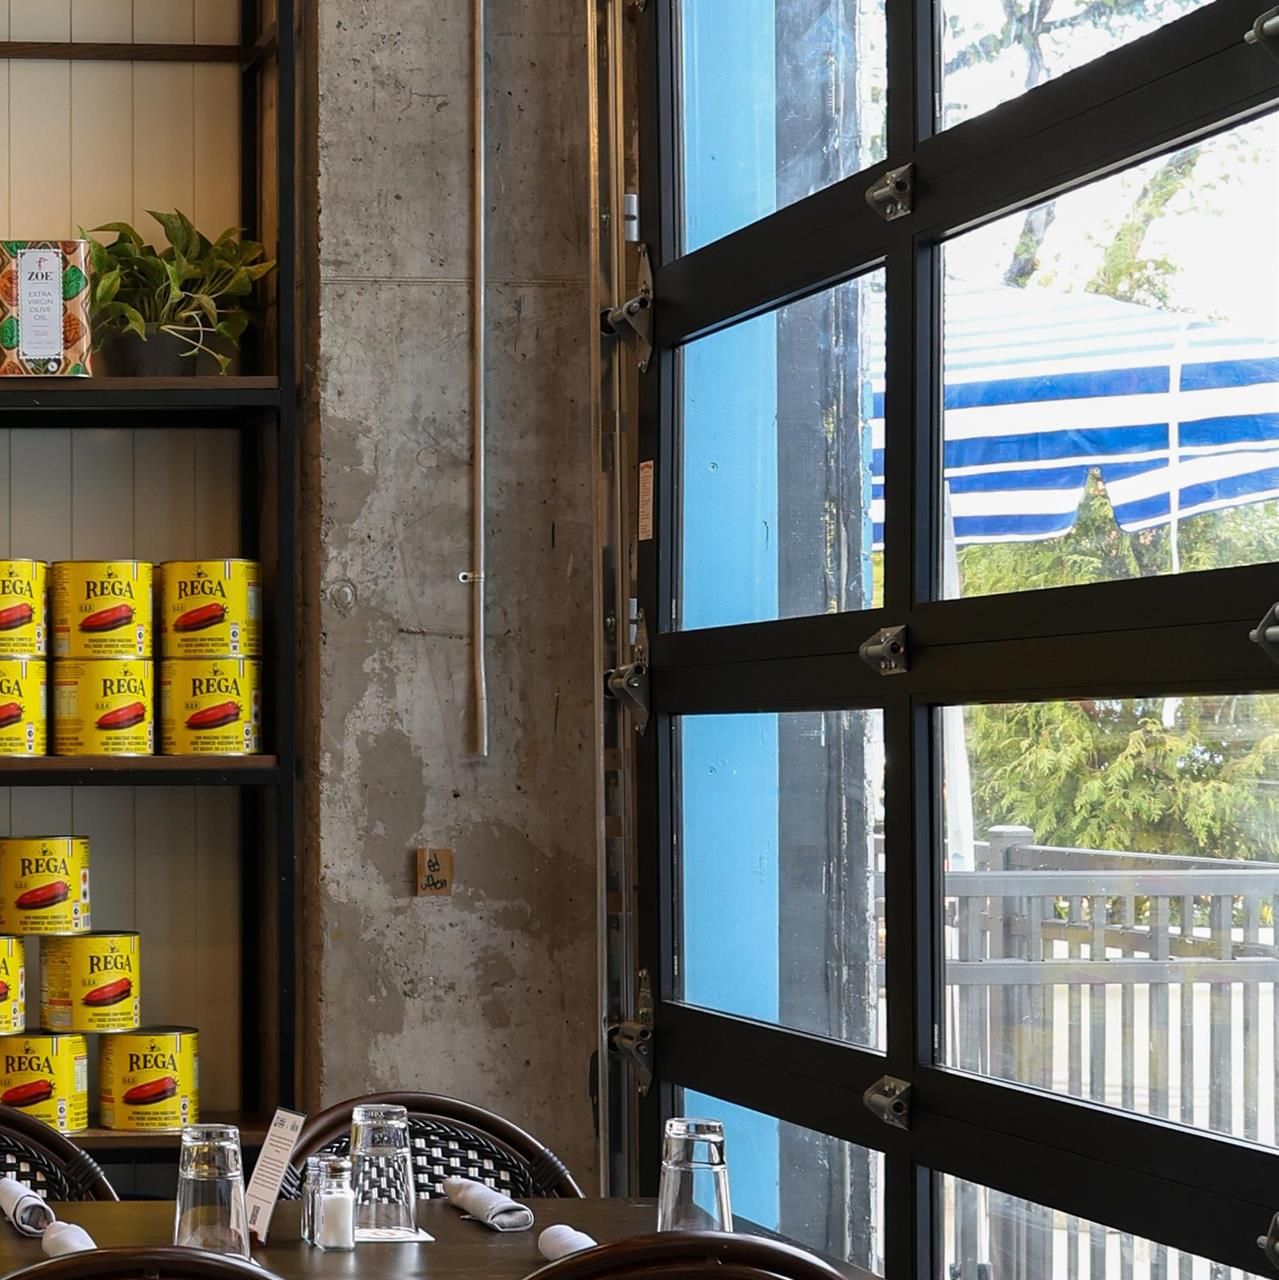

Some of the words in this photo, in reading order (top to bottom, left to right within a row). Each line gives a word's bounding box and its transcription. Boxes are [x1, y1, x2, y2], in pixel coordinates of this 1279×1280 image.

[27, 271, 53, 281] ZOE
[85, 580, 135, 600] REGA
[178, 579, 227, 600] REGA
[102, 678, 147, 698] REGA
[192, 678, 241, 697] REGA
[20, 858, 70, 877] REGA
[89, 955, 132, 975] REGA
[4, 1055, 55, 1075] REGA
[128, 1053, 178, 1072] REGA
